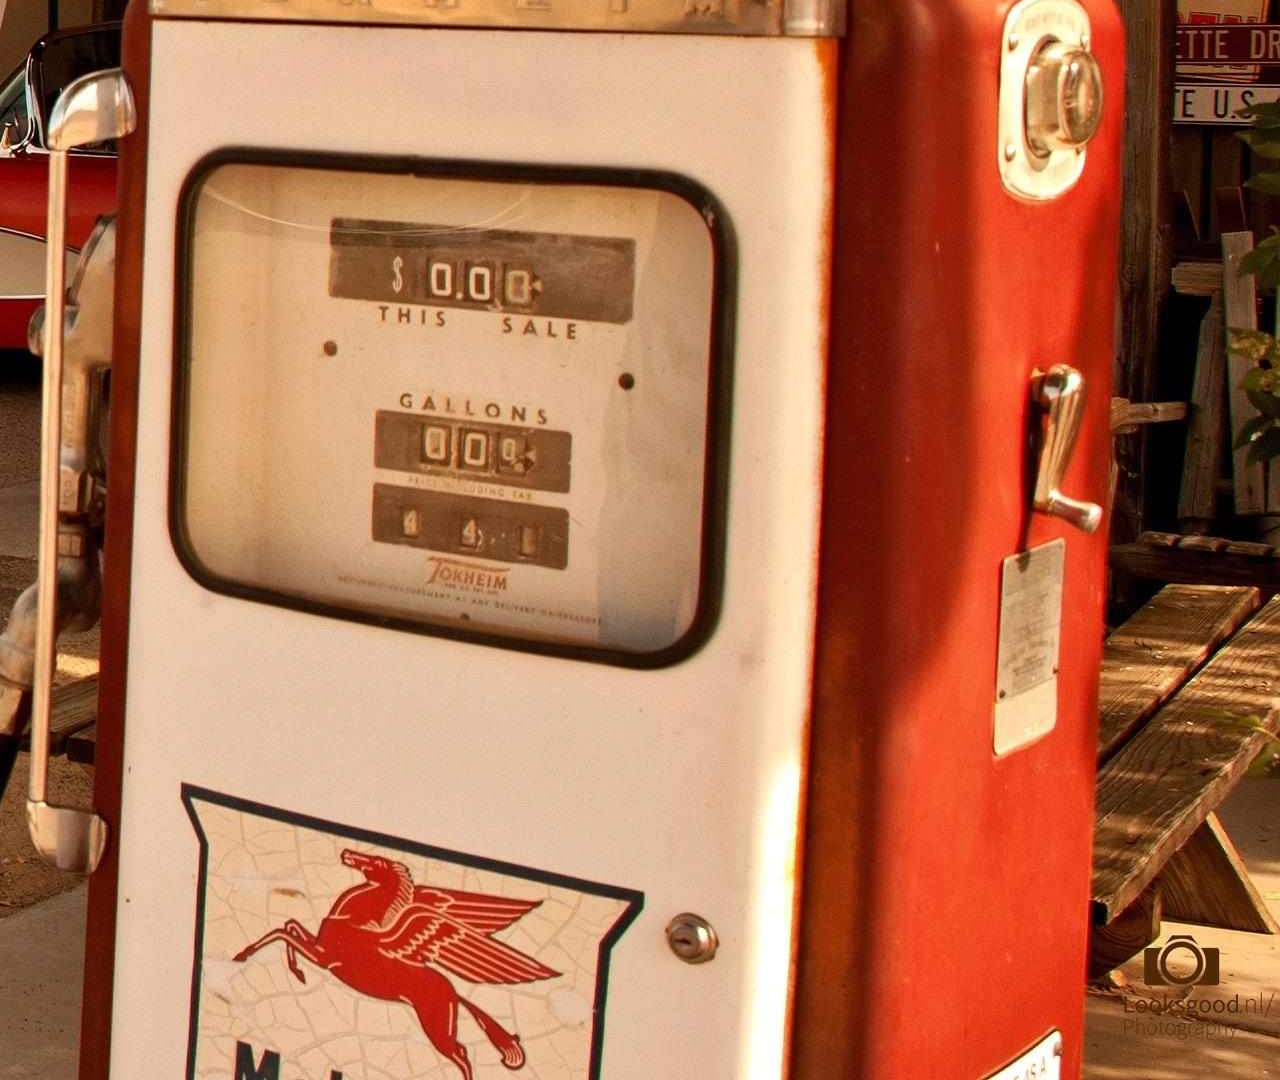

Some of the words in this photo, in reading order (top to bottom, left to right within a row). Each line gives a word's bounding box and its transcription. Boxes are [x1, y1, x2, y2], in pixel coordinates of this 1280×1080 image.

[1251, 29, 1280, 60] DR
[379, 305, 446, 327] THIS
[502, 318, 577, 340] SALE
[399, 393, 548, 425] GALLONS
[408, 476, 437, 489] PRICE
